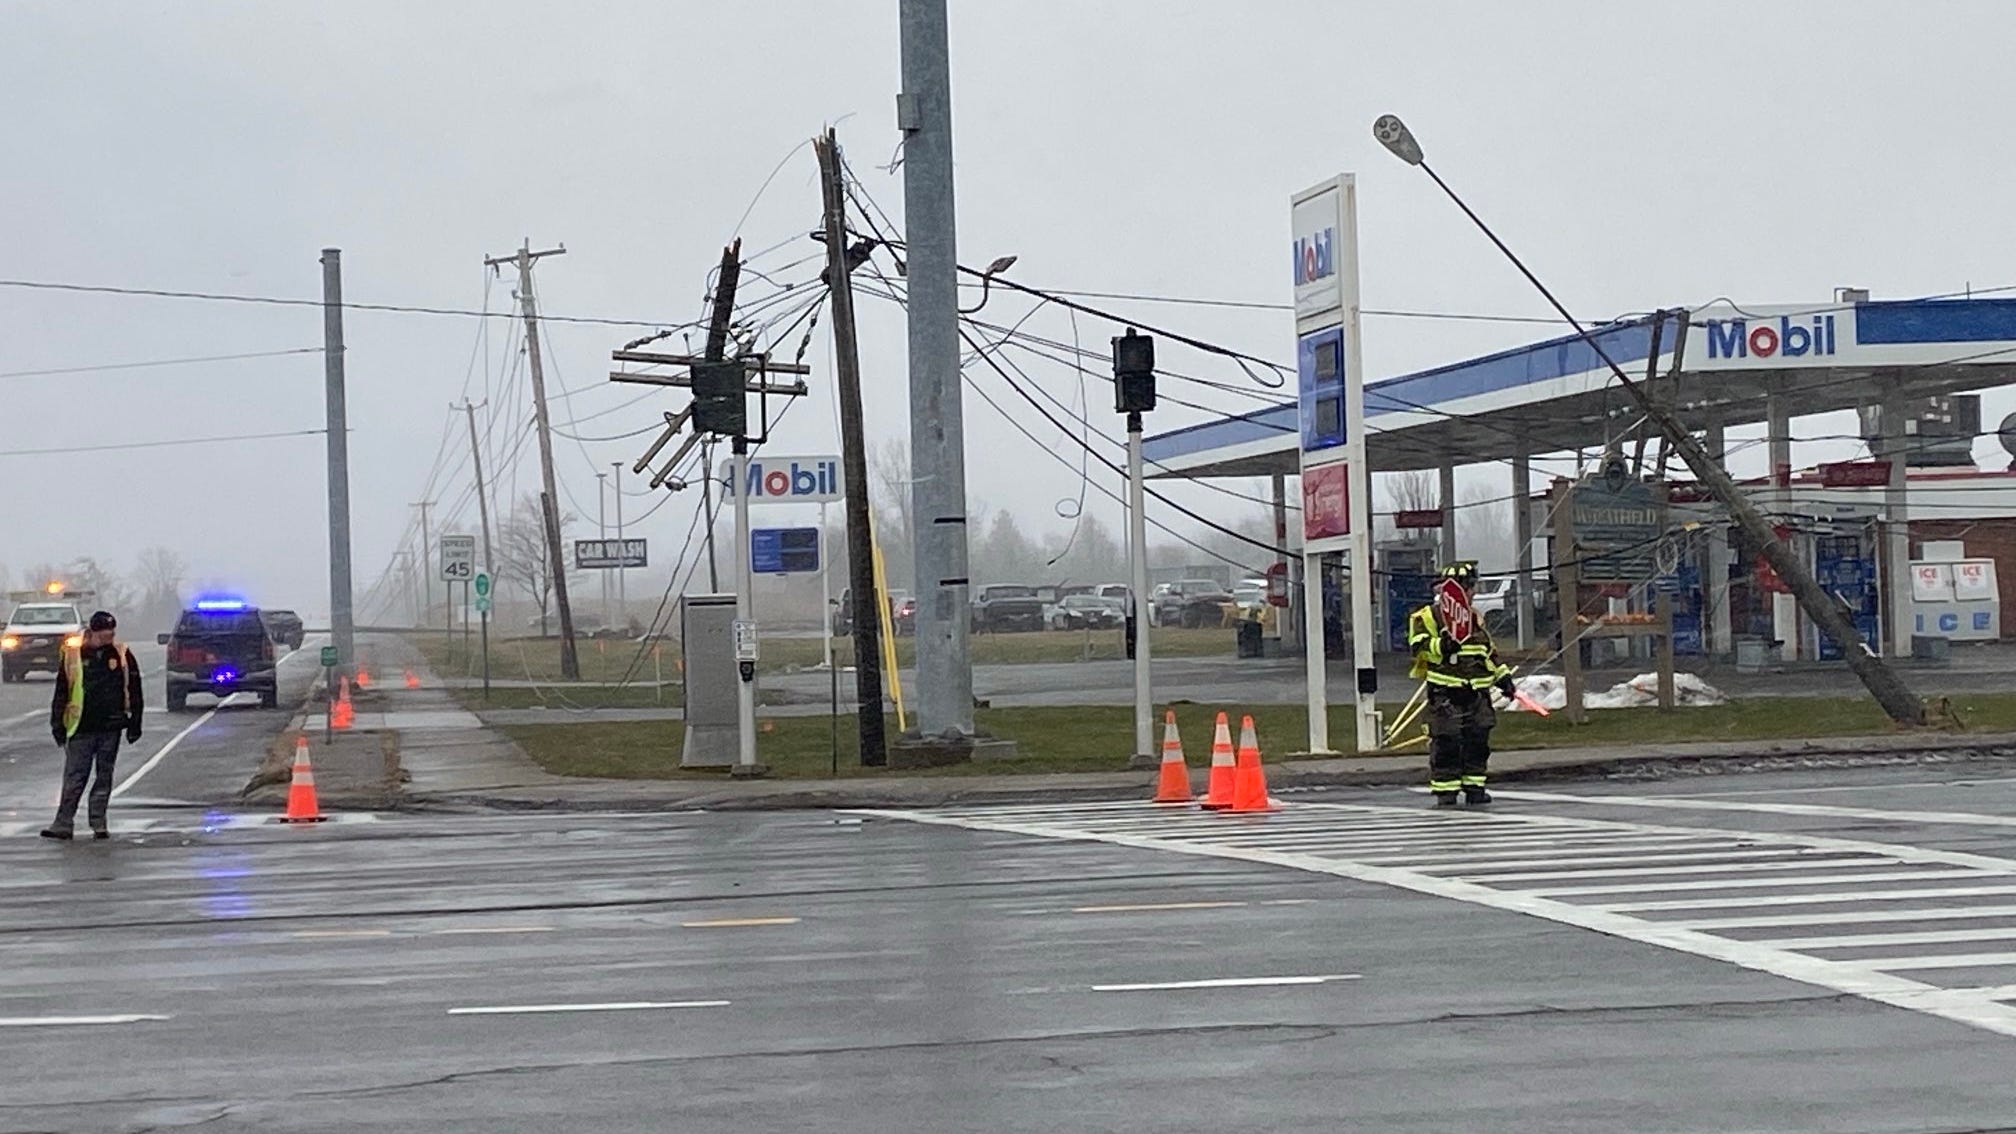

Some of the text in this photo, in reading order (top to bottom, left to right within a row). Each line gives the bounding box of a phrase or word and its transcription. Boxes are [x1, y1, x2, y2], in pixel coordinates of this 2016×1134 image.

[1293, 227, 1334, 286] Mobil
[1707, 315, 1835, 359] Mobil
[730, 461, 837, 497] Mobil
[578, 541, 645, 558] CAR WASH
[445, 562, 470, 577] 45
[1919, 568, 1938, 579] ICE
[1963, 566, 1982, 577] ICE
[1443, 591, 1469, 628] STOP
[1916, 612, 1991, 633] ICE
